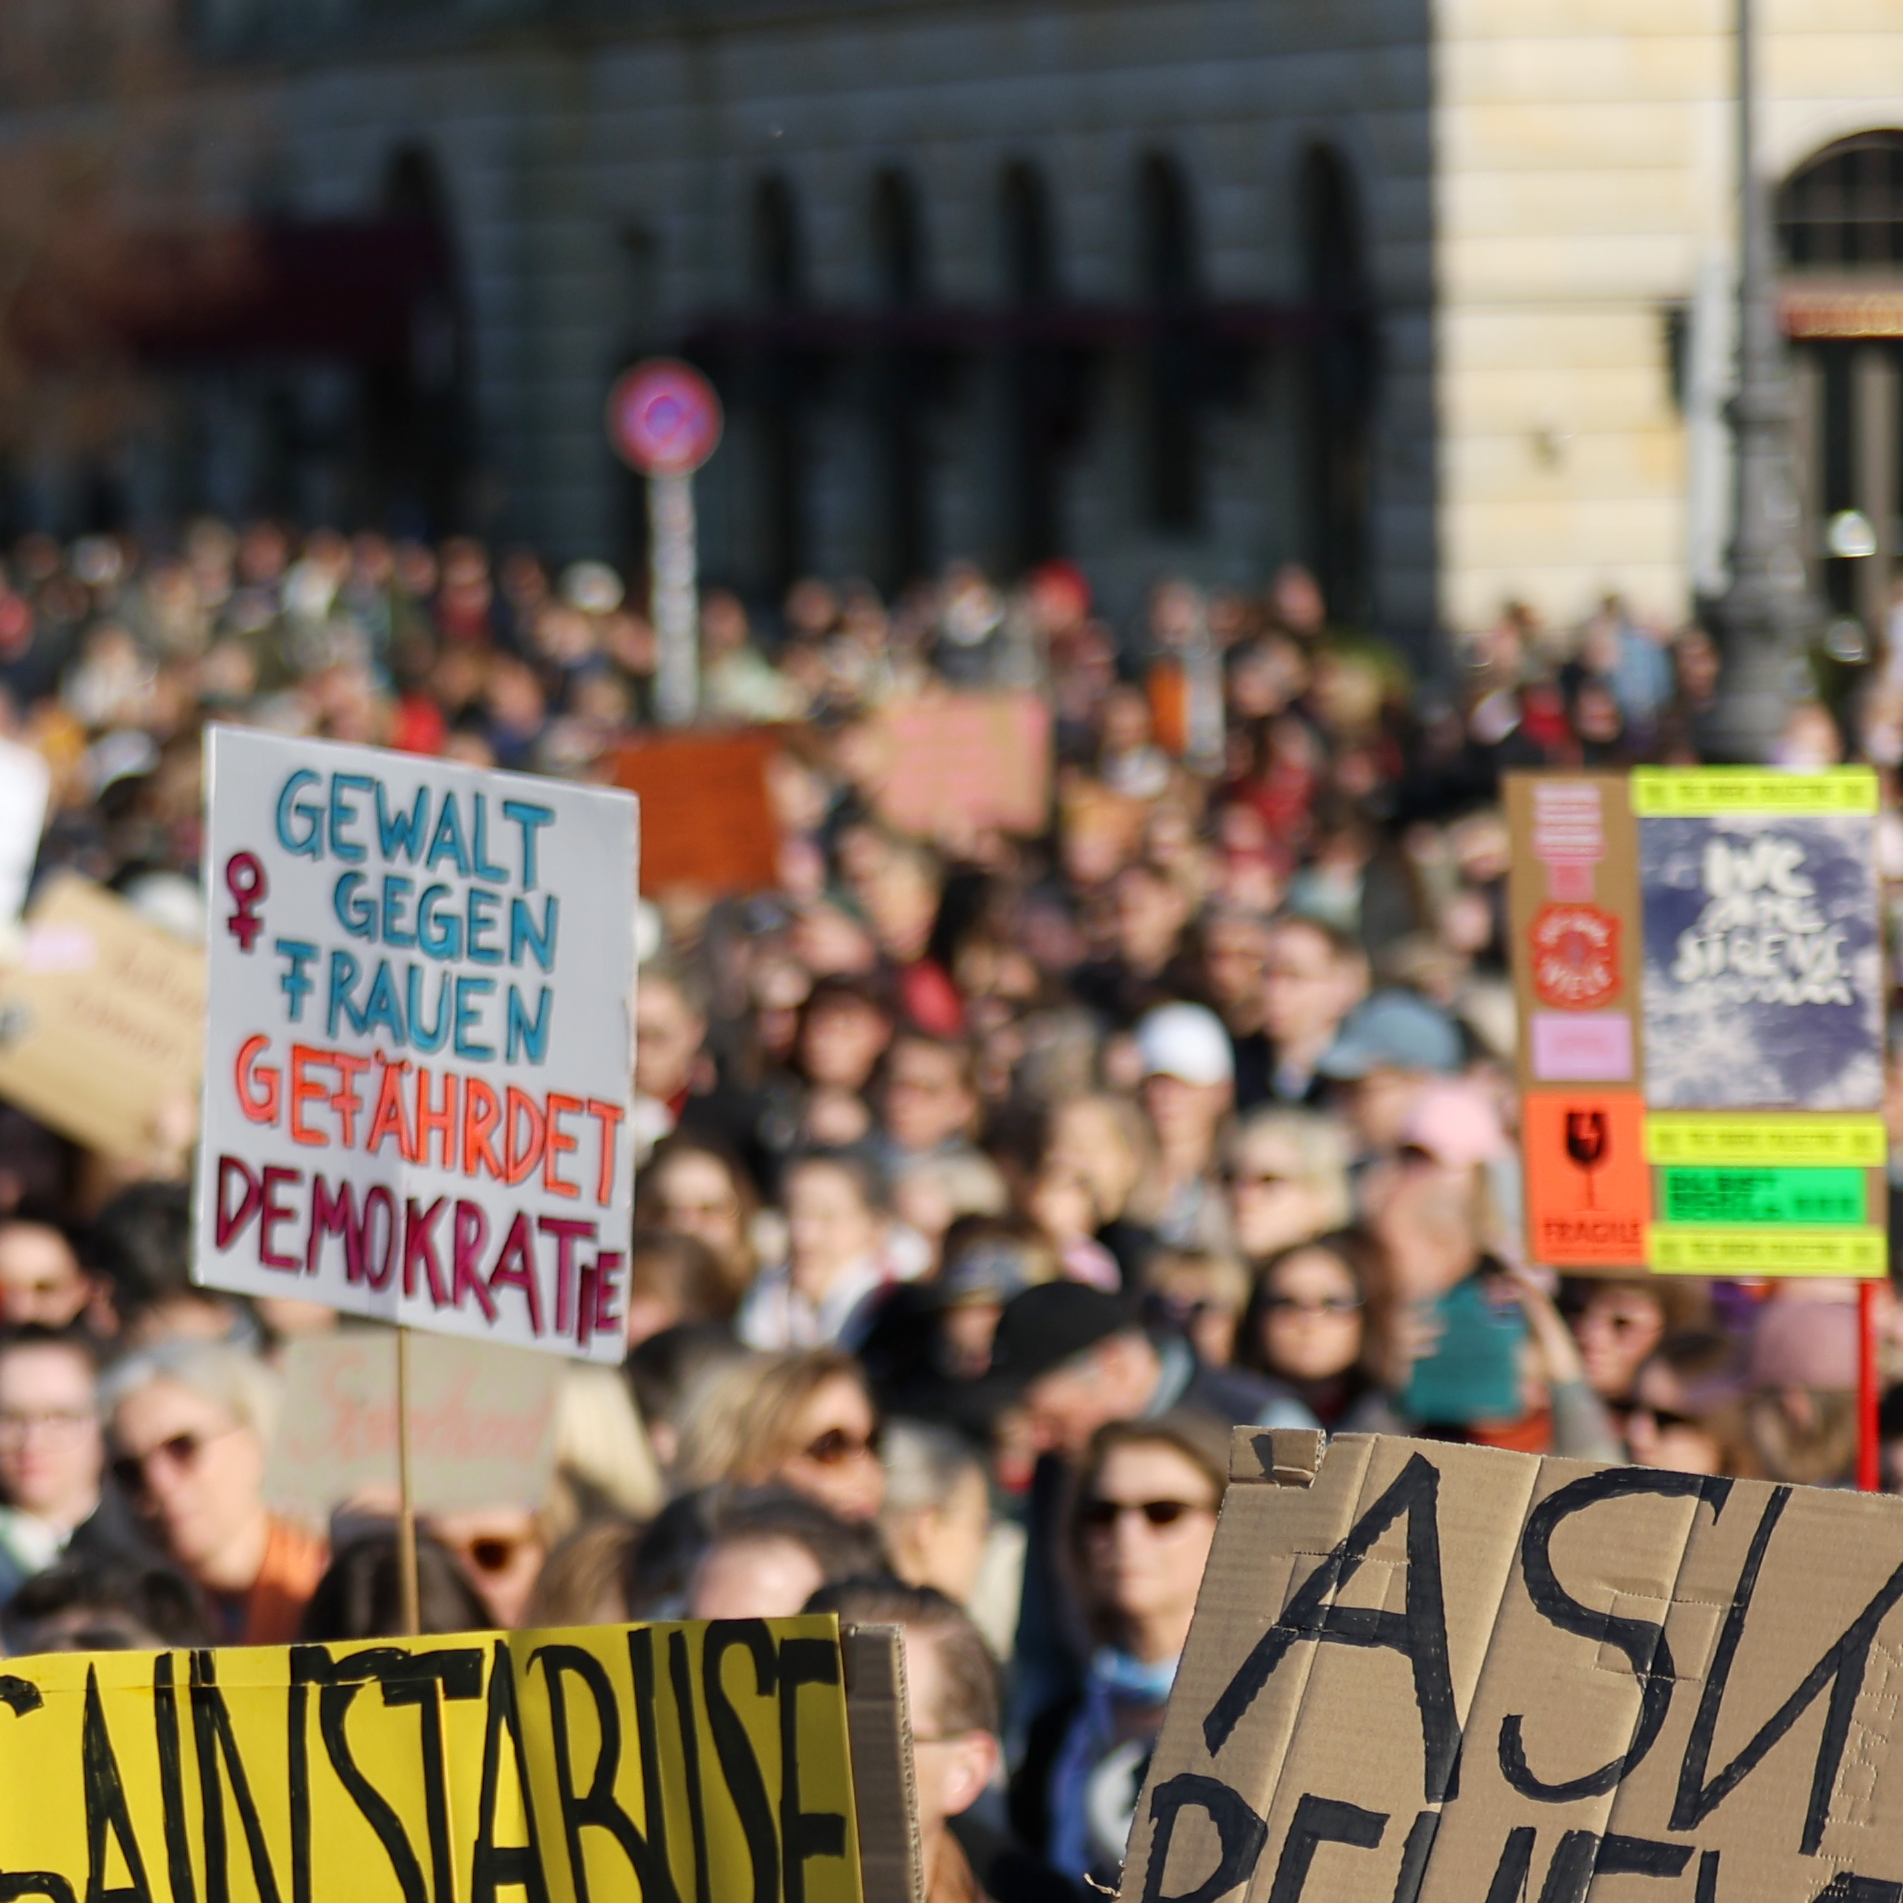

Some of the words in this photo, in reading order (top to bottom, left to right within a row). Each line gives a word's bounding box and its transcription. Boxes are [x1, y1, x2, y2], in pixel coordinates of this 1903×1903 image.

[275, 767, 557, 894] GEWALT
[334, 868, 559, 973] GEGEN
[275, 938, 553, 1065] FRAUEN
[234, 1033, 625, 1206] GEFÄHRDET
[215, 1154, 626, 1348] DEMOKRATIE
[1543, 1218, 1643, 1244] FRAGILE
